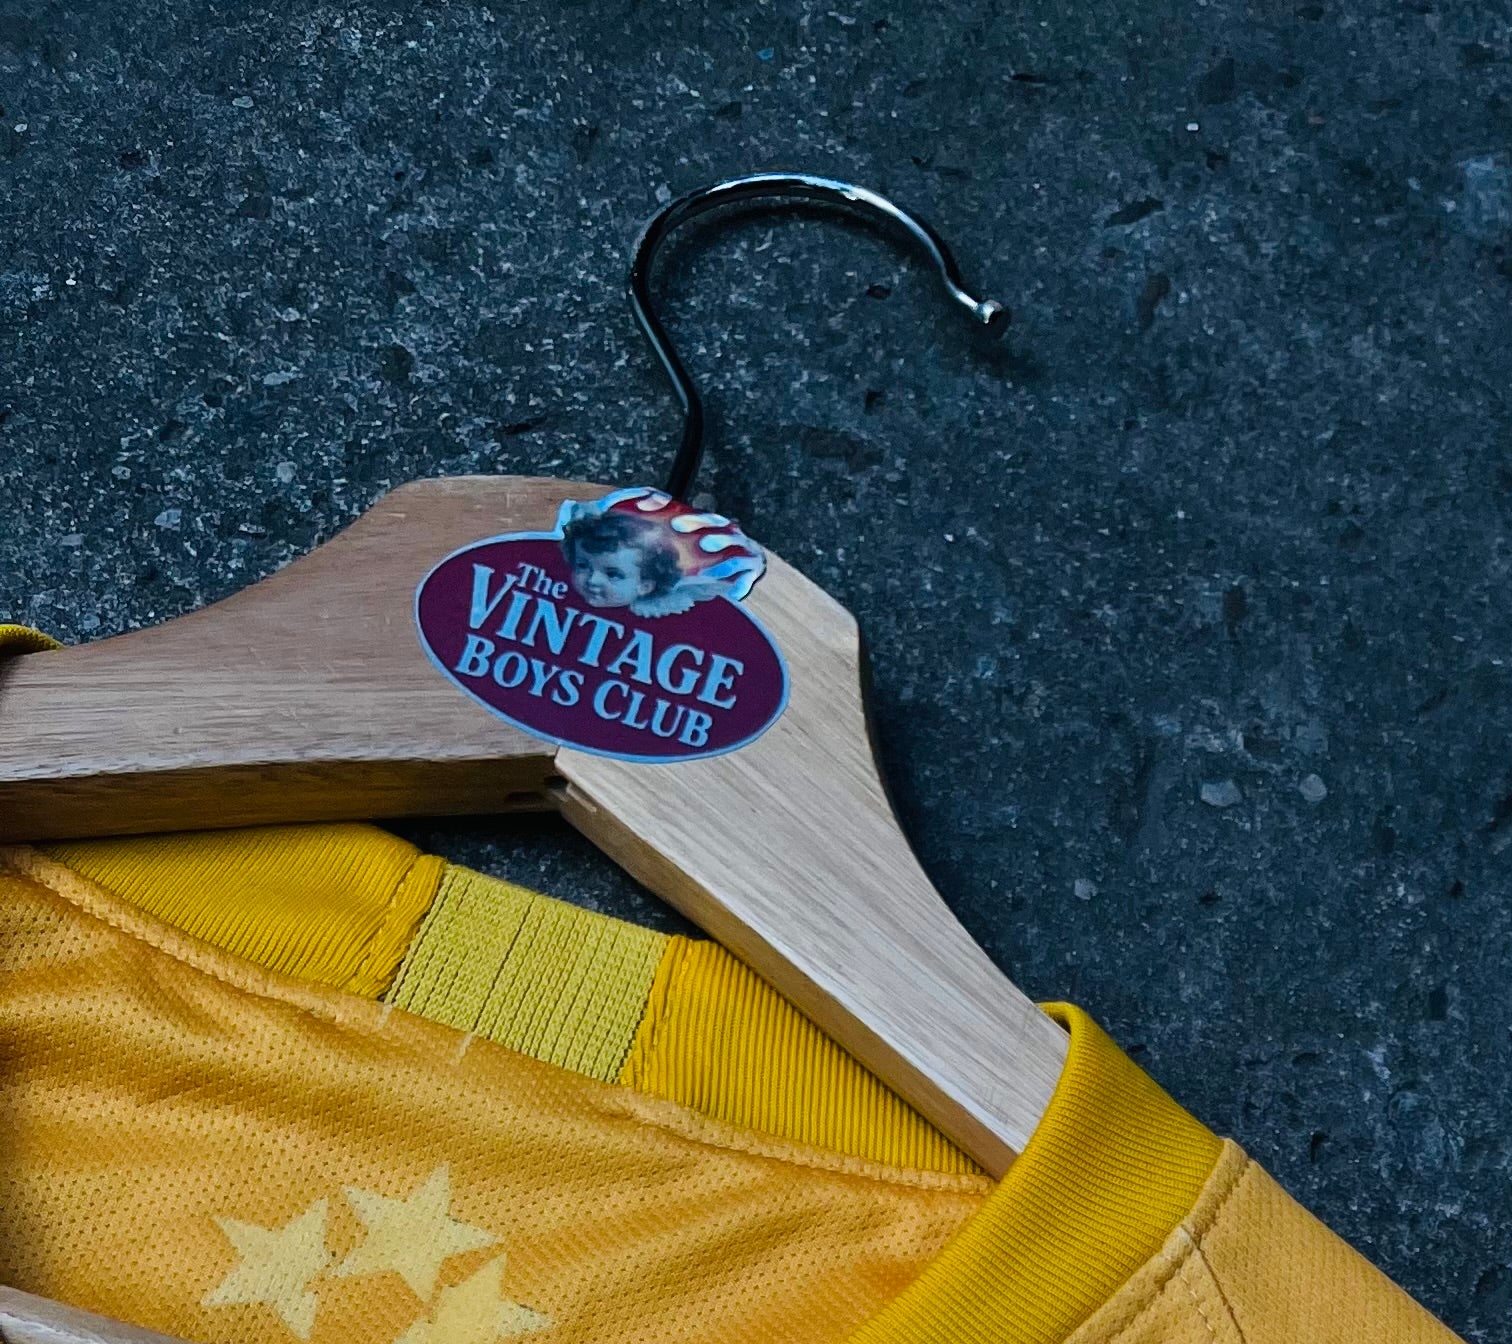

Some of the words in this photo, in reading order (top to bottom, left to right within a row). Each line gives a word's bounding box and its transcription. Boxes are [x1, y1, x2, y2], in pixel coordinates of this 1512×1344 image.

[467, 563, 745, 711] VINTAGE
[516, 561, 569, 600] The
[454, 633, 585, 707] BOYS
[593, 679, 714, 748] CLUB
